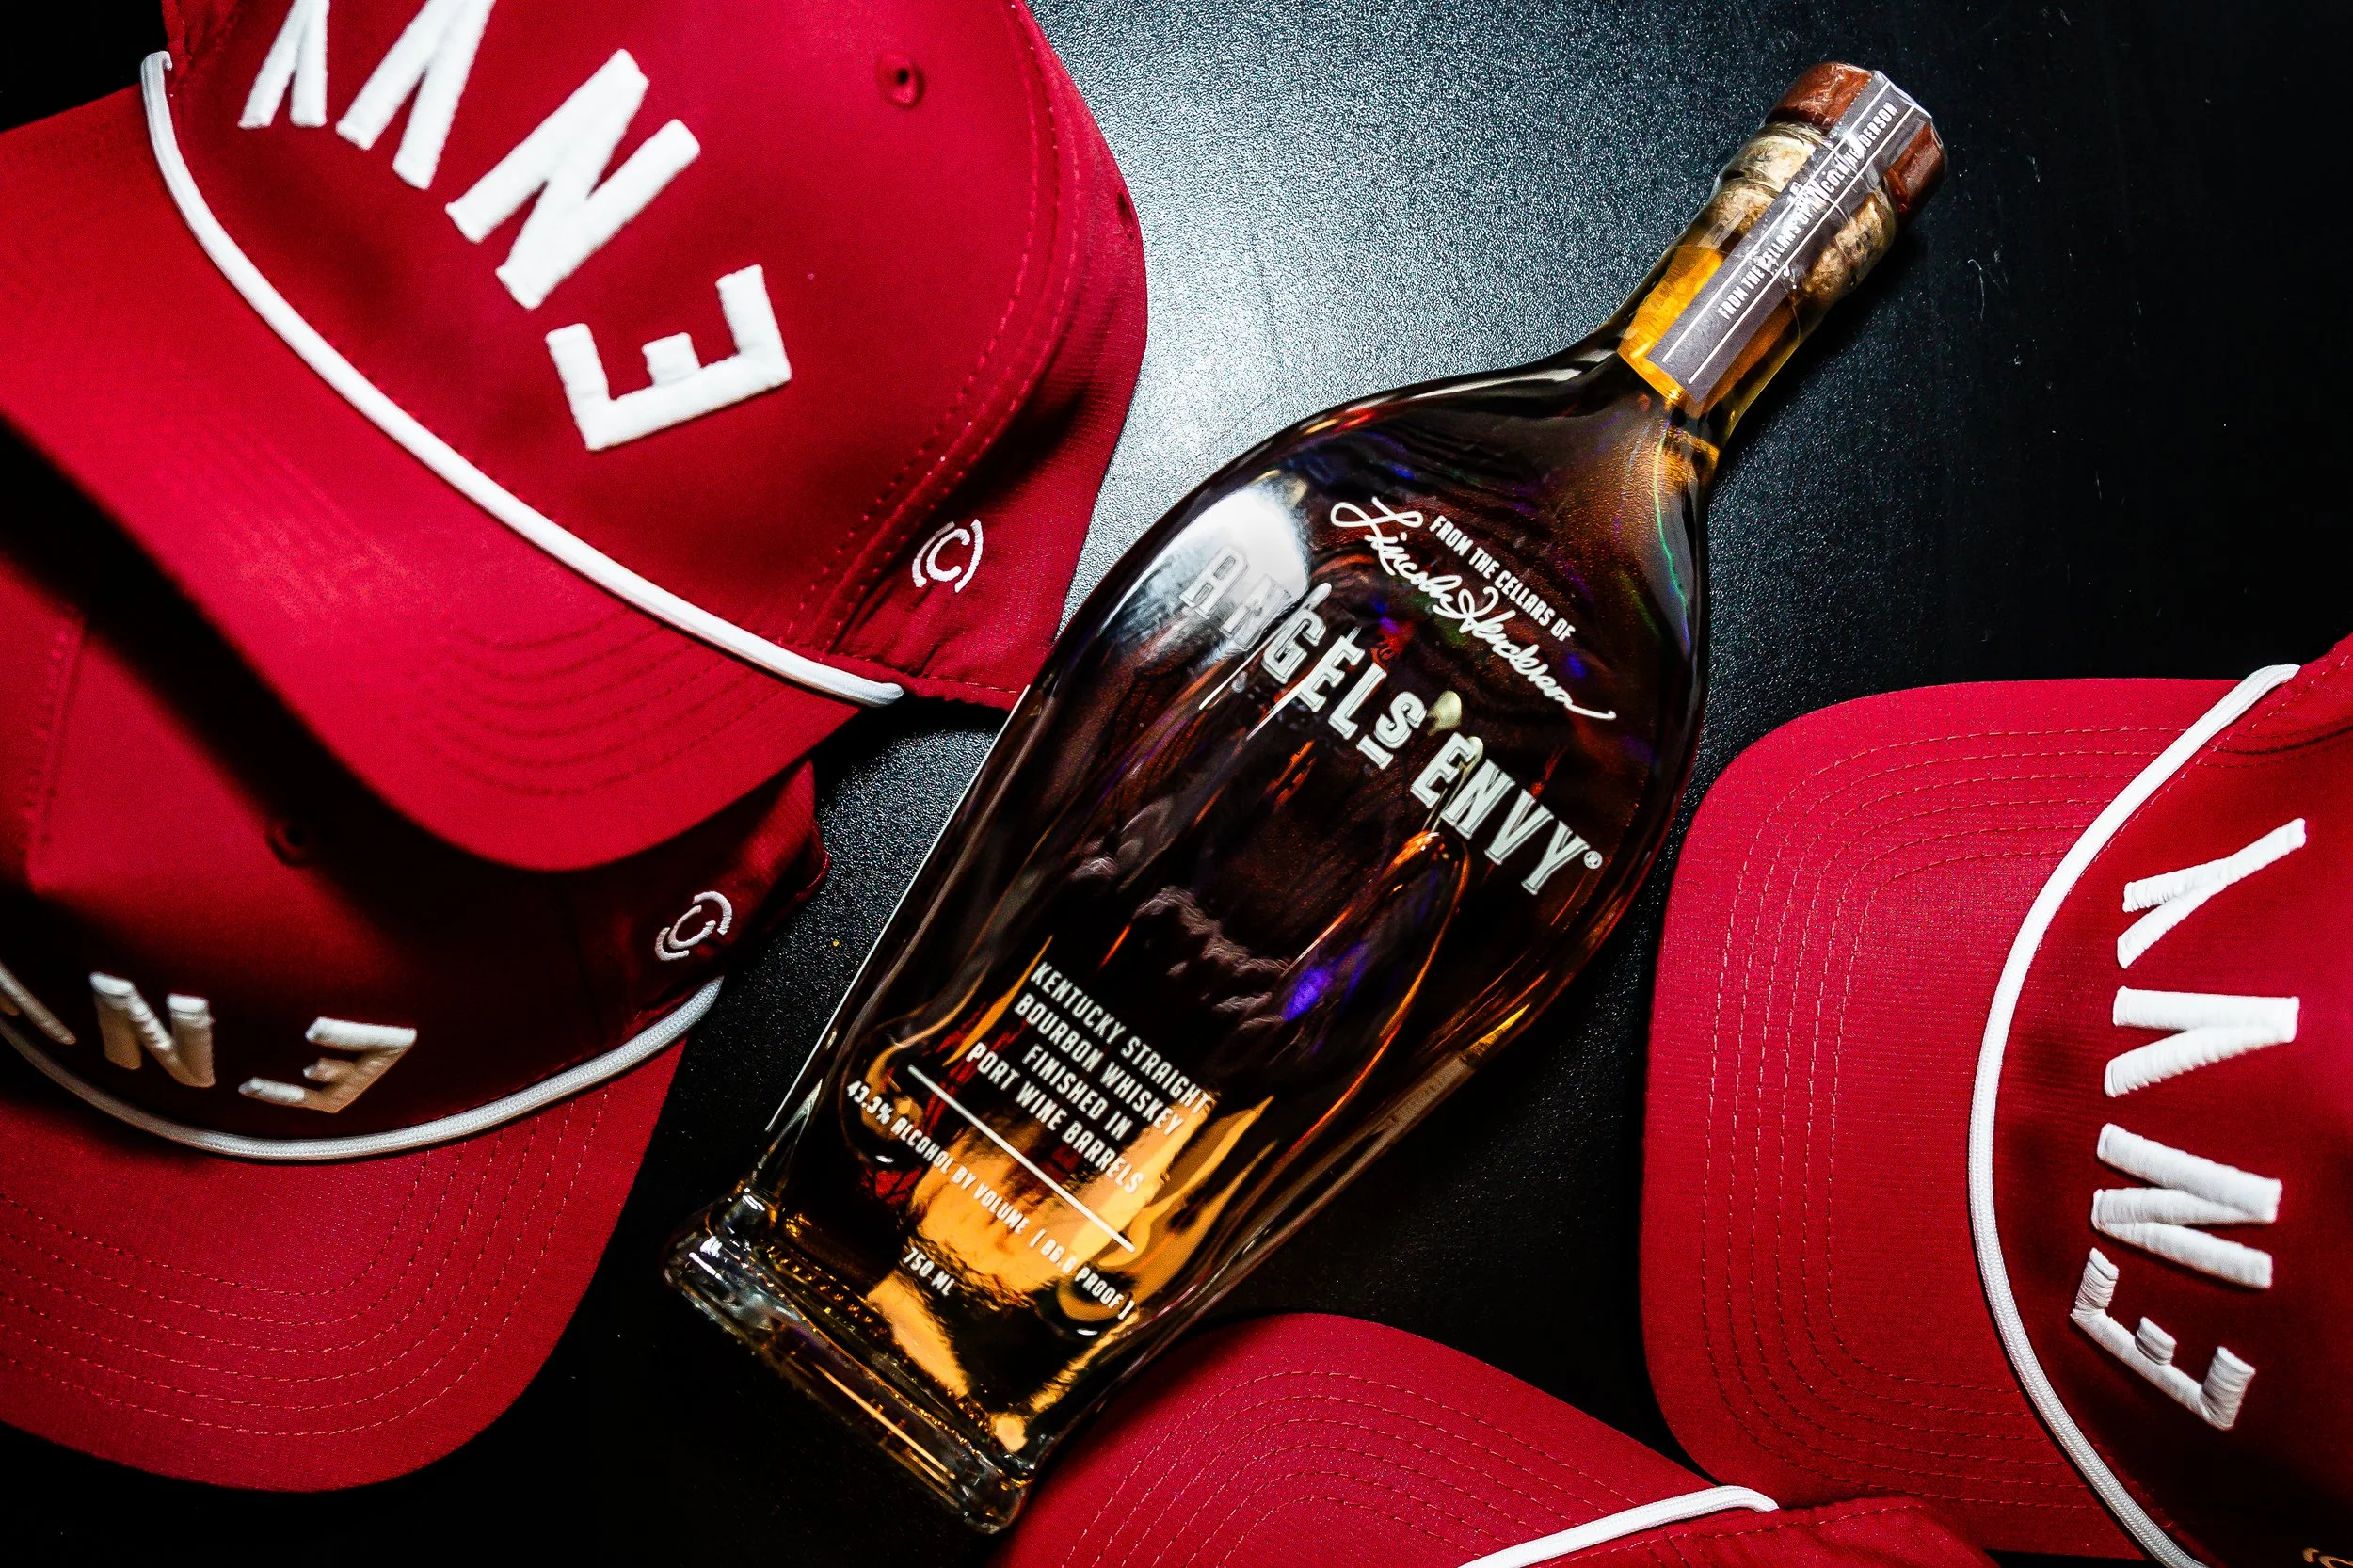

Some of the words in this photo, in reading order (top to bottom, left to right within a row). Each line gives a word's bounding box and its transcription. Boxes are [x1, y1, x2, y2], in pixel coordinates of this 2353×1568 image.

[1717, 286, 1749, 320] FROM
[1742, 266, 1767, 292] THE
[1429, 515, 1473, 556] FROM
[1468, 547, 1500, 580] THE
[1494, 570, 1555, 627] CELLARS
[1550, 618, 1576, 642] OF
[1014, 992, 1104, 1073] BOURBON
[1099, 1061, 1184, 1135] WHISKEY
[1022, 1043, 1109, 1120] FINISHED
[1104, 1110, 1133, 1141] IN
[1031, 961, 1127, 1045] KENTUCKY
[1120, 1035, 1212, 1114] STRAIGHT
[847, 1080, 893, 1125] 43.3%
[890, 1116, 955, 1175] ALCOHOL
[951, 1165, 977, 1190] BY
[973, 1182, 1031, 1235] VOLUME
[966, 1041, 1021, 1091] PORT
[1015, 1080, 1068, 1131] WINE
[1062, 1120, 1144, 1194] BARRELS
[2071, 818, 2306, 1431] ENVY
[903, 1247, 935, 1278] 750
[931, 1271, 956, 1297] ML
